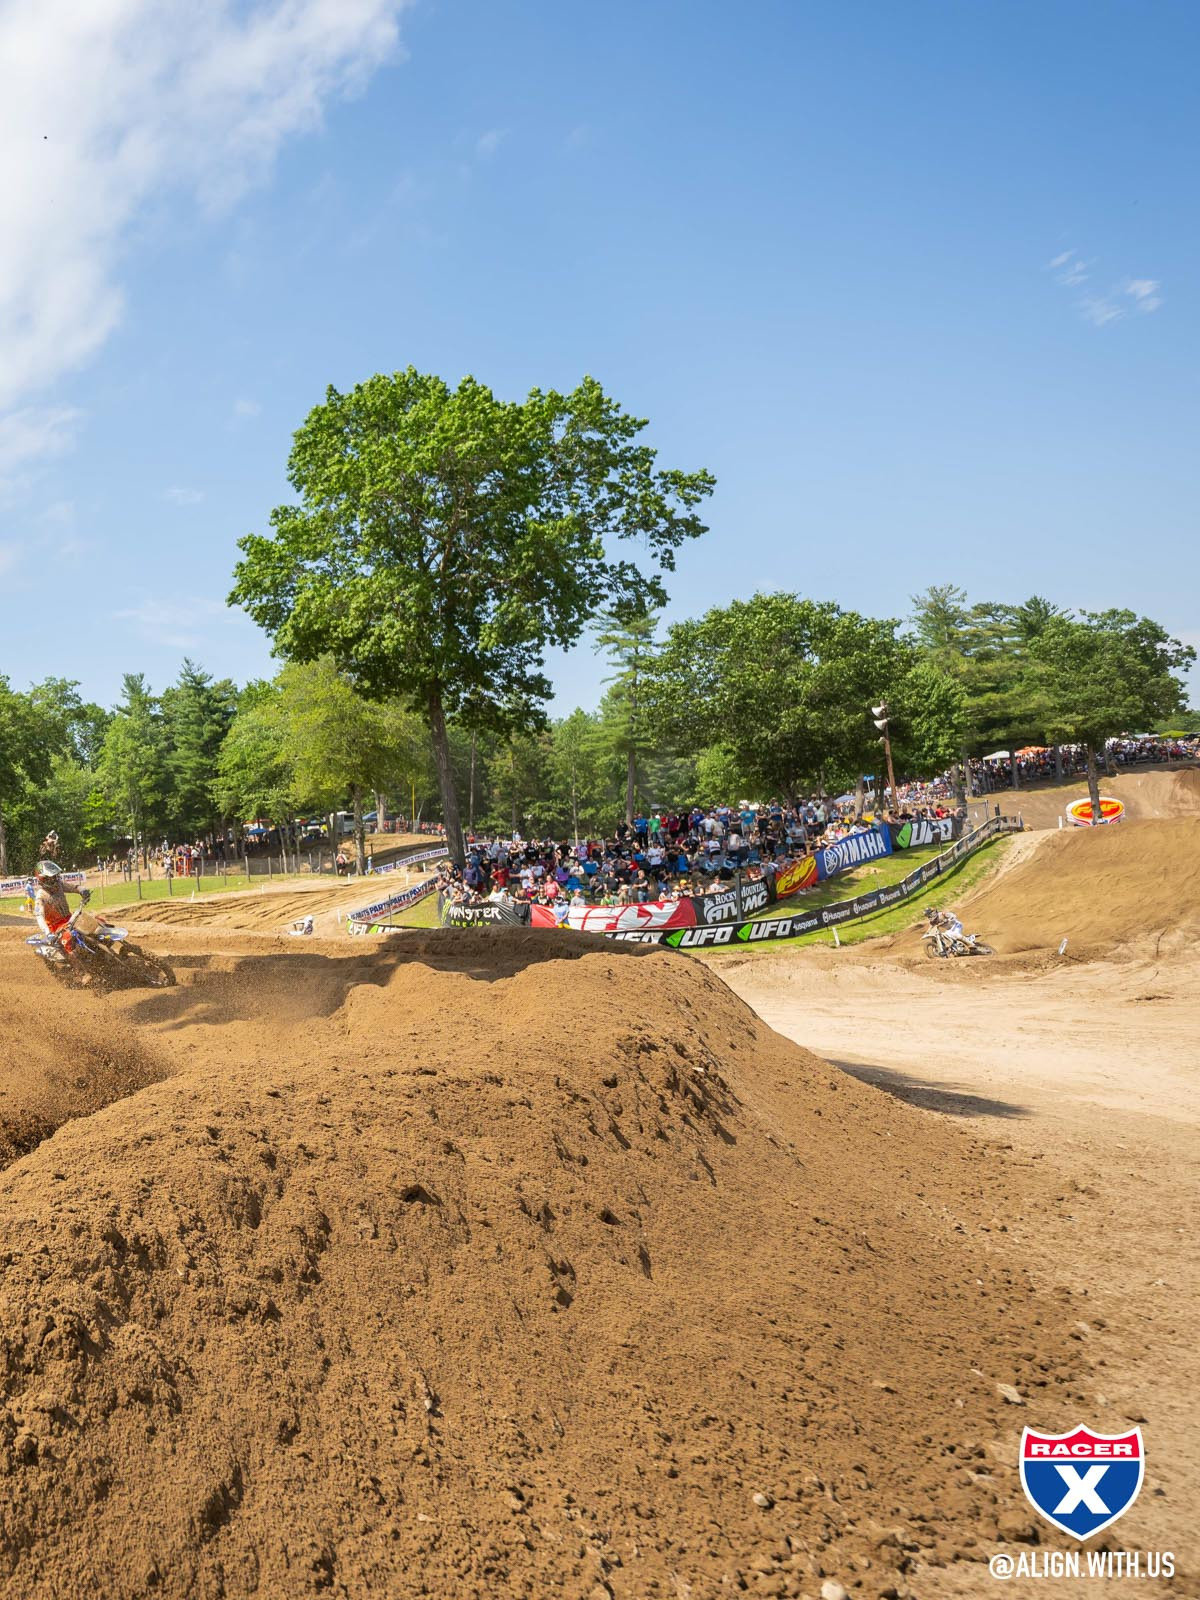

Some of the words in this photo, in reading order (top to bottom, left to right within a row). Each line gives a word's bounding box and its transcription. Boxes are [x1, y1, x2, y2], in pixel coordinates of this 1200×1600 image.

[835, 832, 886, 867] YAMAHA
[714, 891, 737, 905] ROCKY
[680, 926, 733, 946] UFO
[750, 920, 792, 939] UFO
